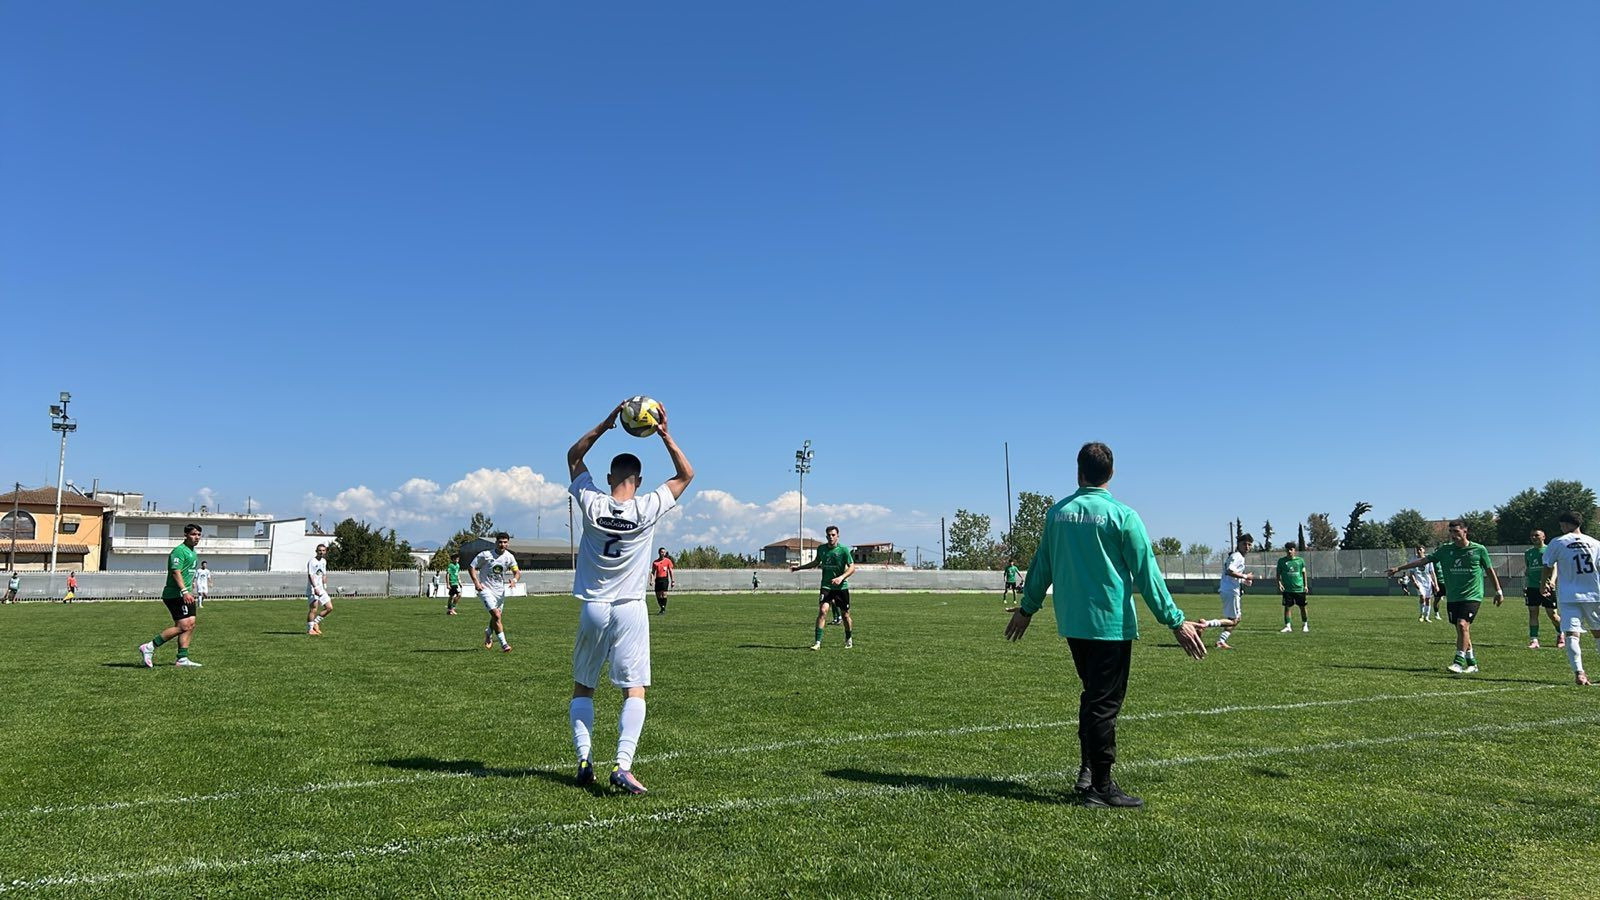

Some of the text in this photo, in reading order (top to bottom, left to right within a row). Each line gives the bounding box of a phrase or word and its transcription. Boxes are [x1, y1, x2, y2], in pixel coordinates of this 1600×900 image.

[603, 533, 623, 558] 2
[1573, 553, 1594, 574] 13
[182, 605, 189, 616] 9
